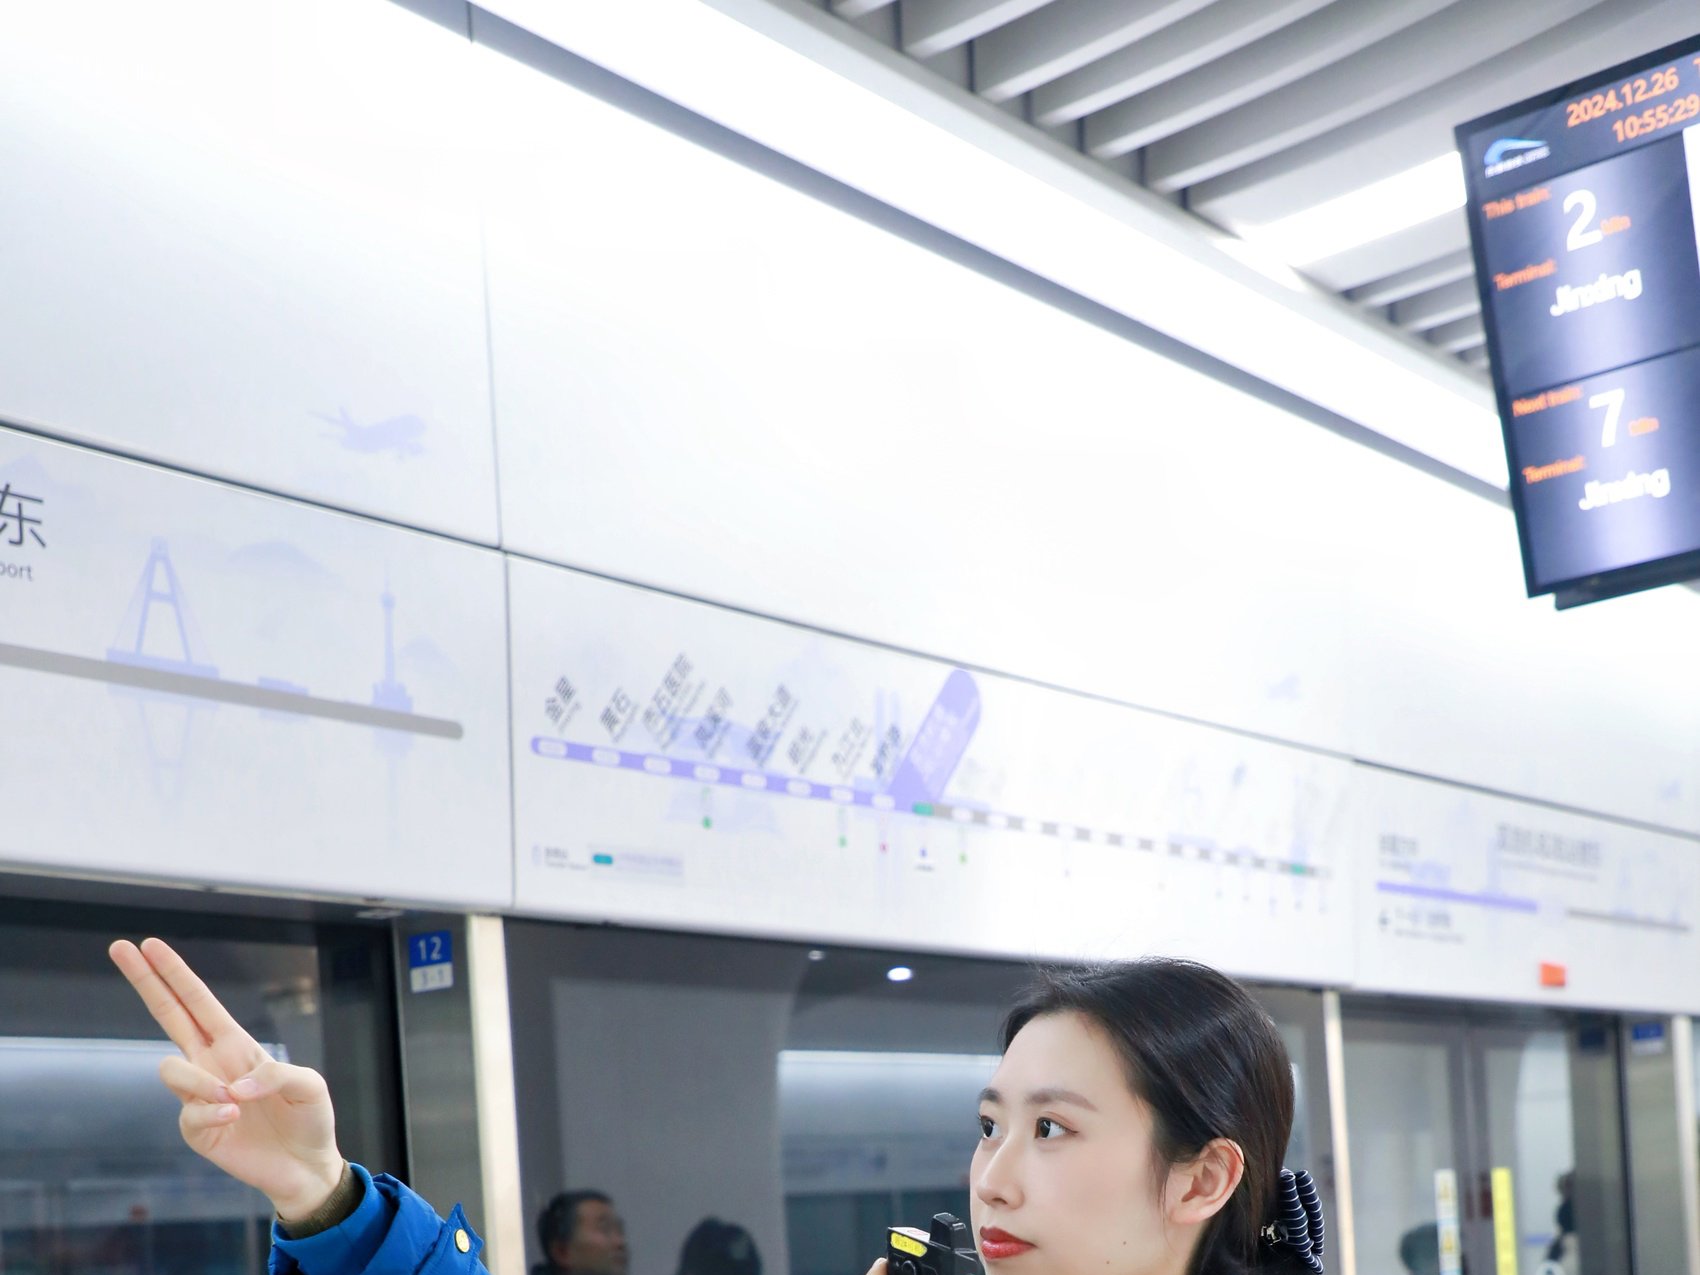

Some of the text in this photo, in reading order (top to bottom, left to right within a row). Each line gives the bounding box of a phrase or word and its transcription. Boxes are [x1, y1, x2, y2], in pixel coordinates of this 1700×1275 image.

[1566, 66, 1679, 128] 2024.12.26
[1563, 189, 1604, 252] 2
[1589, 388, 1625, 448] 7
[0, 483, 46, 549] 东
[417, 936, 443, 962] 12
